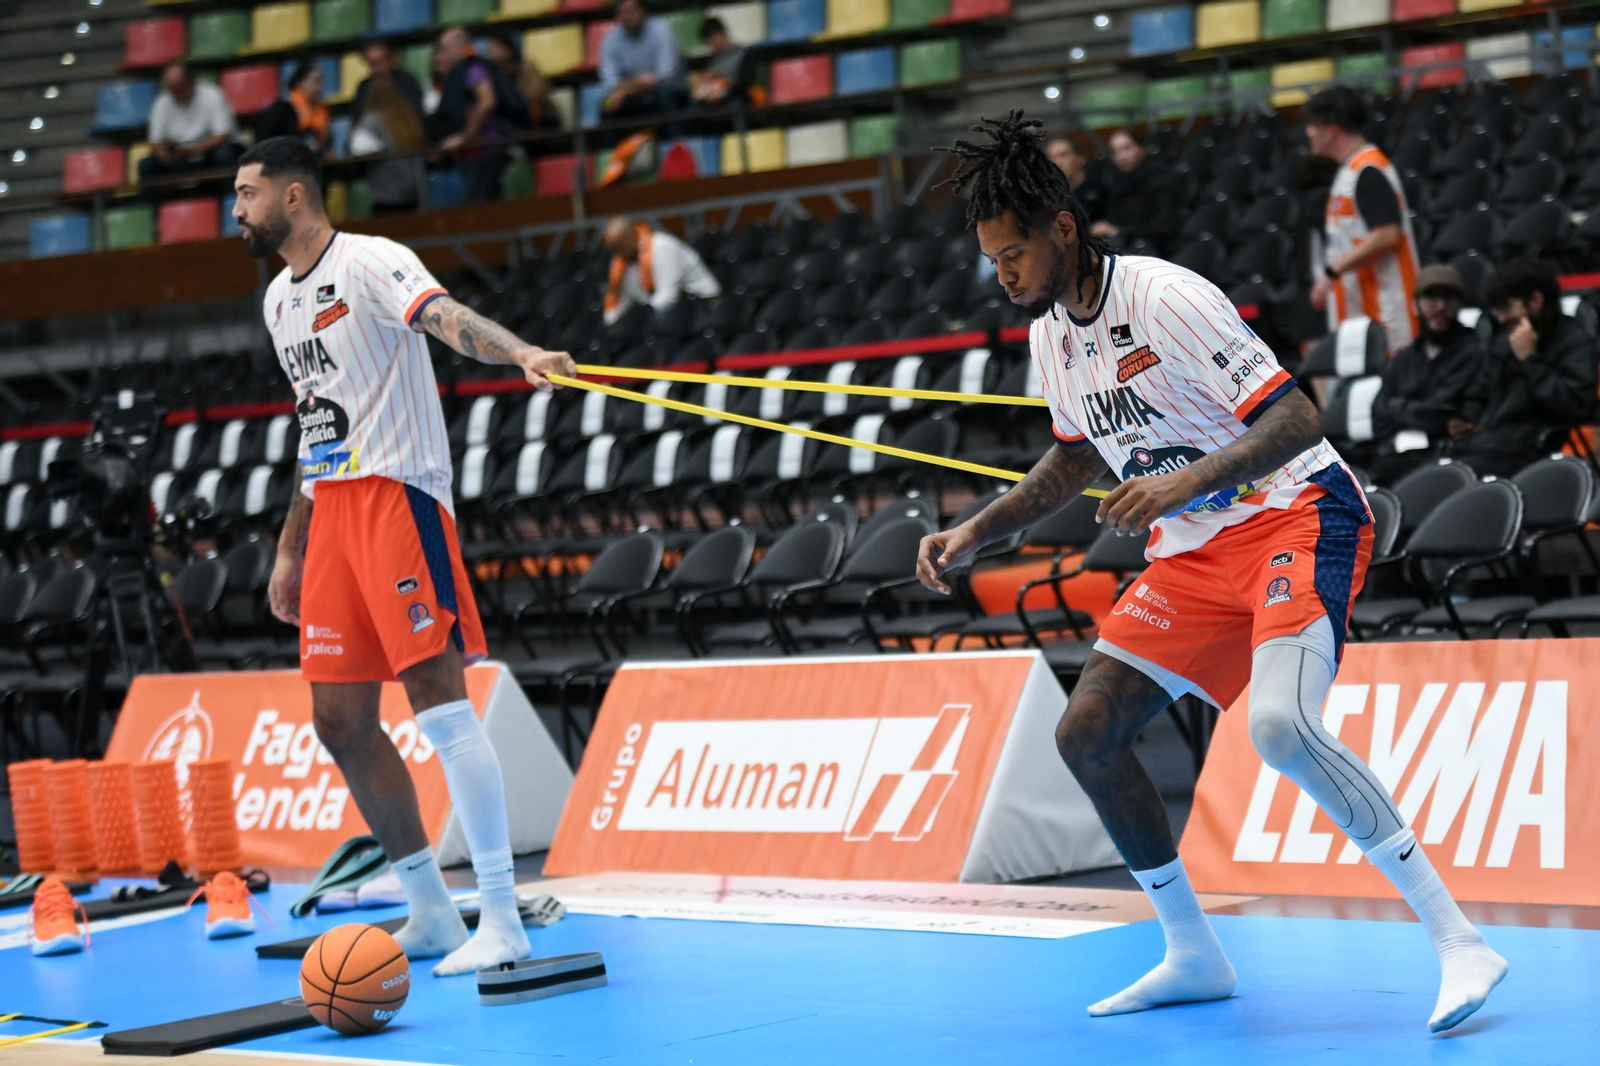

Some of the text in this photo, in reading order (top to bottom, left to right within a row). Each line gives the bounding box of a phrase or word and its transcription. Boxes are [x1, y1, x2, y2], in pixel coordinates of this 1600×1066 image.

[1118, 347, 1149, 368] BASQUET
[1081, 386, 1166, 439] LEYMA
[1116, 432, 1147, 448] NATURA
[1272, 556, 1288, 566] acb
[1143, 594, 1178, 615] DE GALICIA
[1148, 589, 1168, 605] XUNTA
[1112, 602, 1171, 630] galicia
[591, 722, 643, 831] Grupo
[645, 743, 840, 810] Aluman
[1232, 680, 1568, 869] LEYMA
